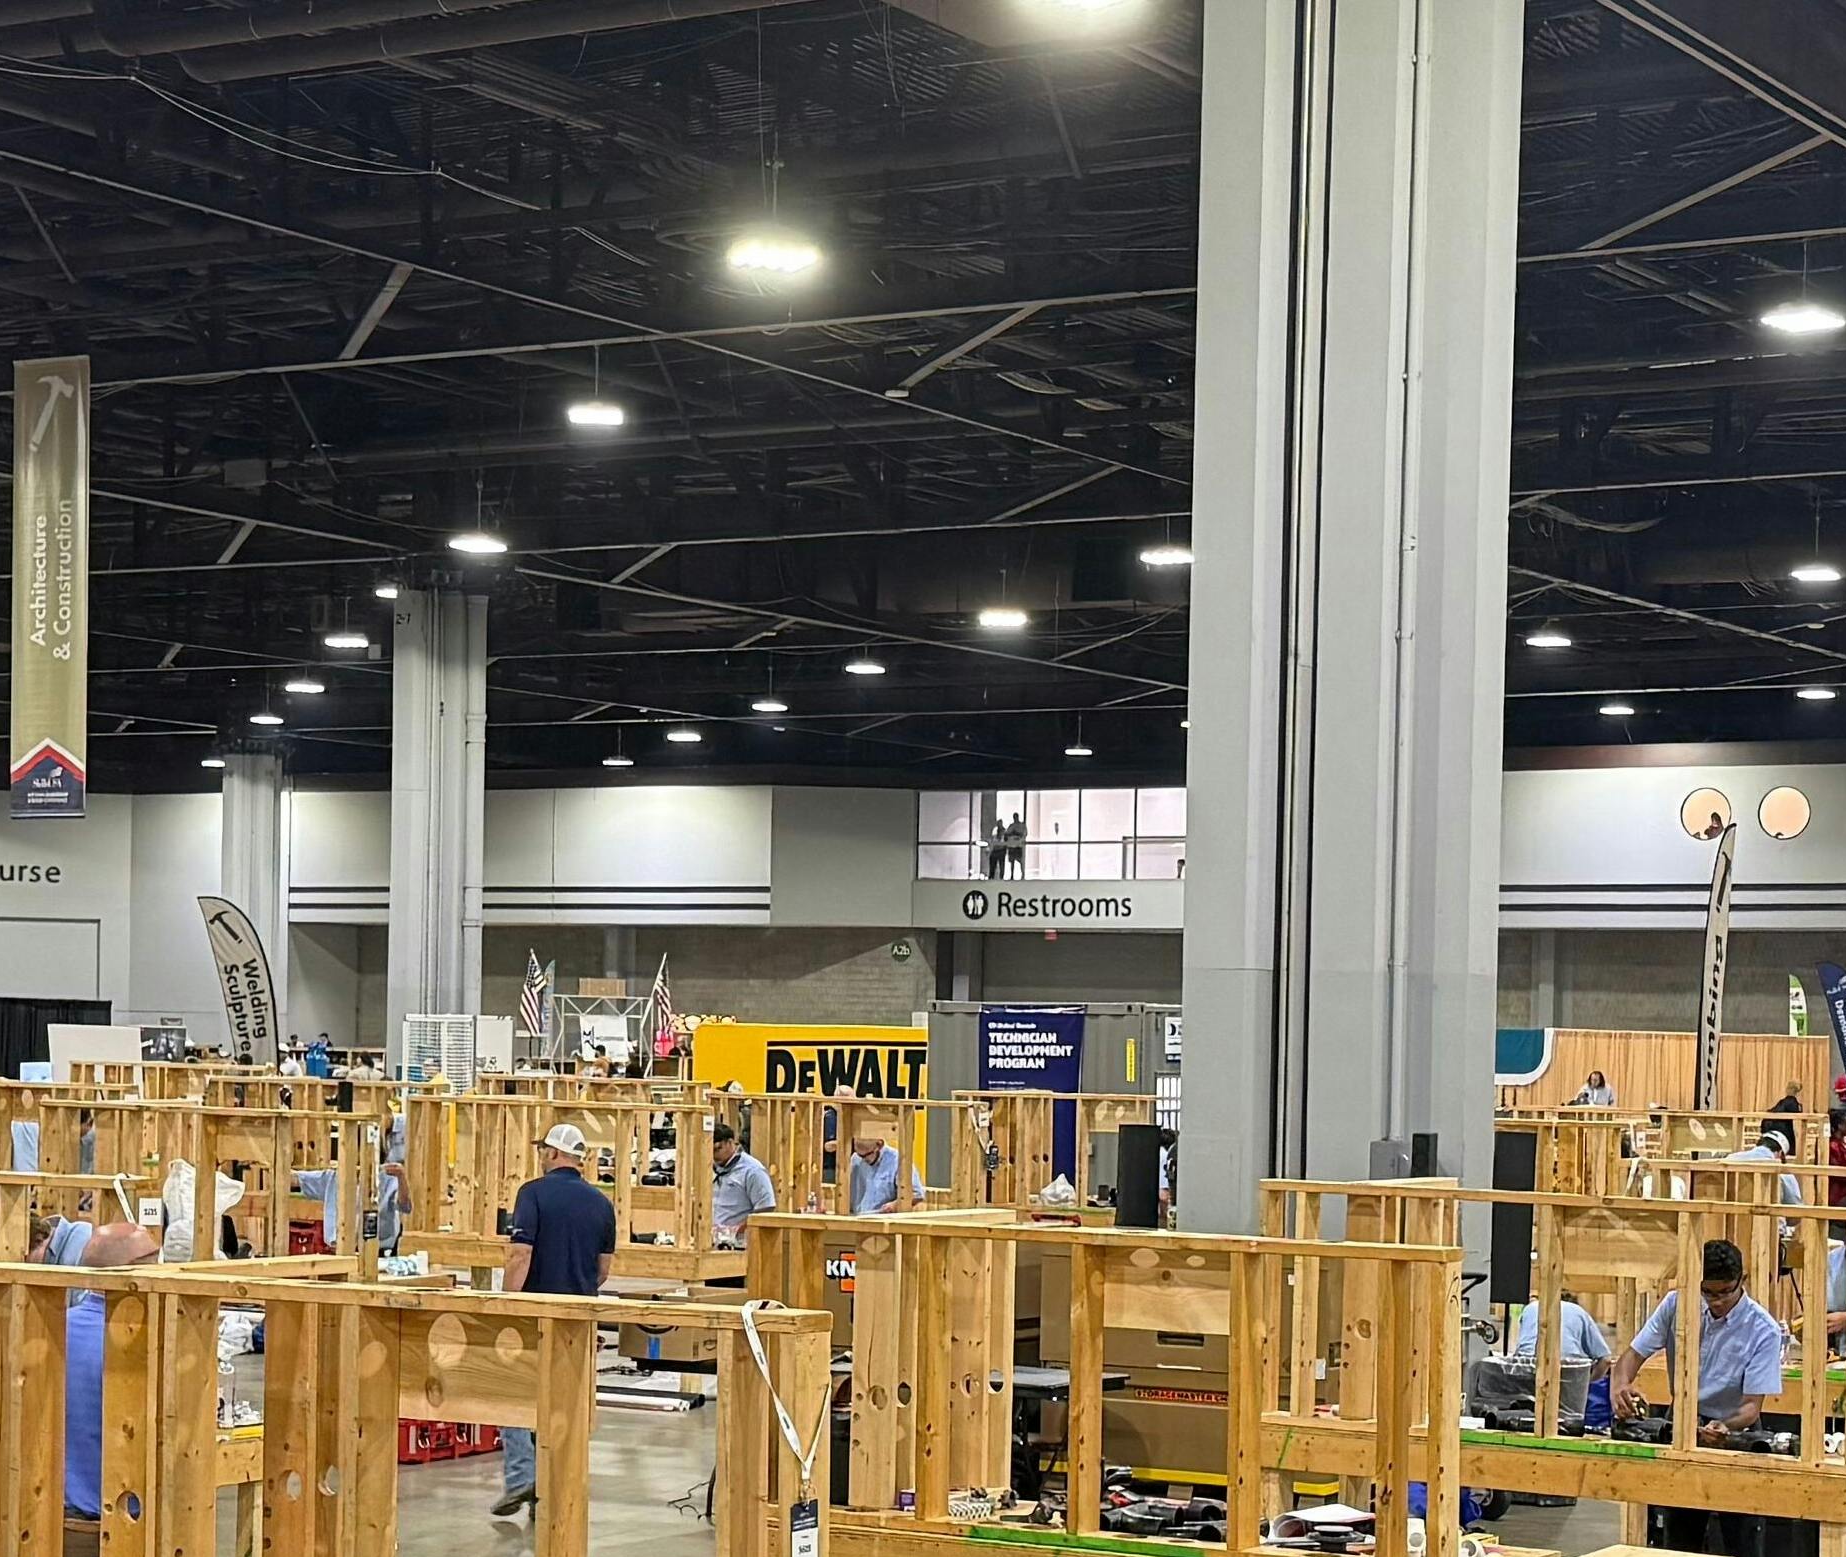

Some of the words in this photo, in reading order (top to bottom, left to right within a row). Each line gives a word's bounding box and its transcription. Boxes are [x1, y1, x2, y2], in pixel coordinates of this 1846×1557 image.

[30, 516, 47, 647] Architecture
[53, 500, 72, 636] Construction
[997, 892, 1132, 918] Restrooms
[224, 963, 252, 1055] Sculpture
[243, 958, 266, 1039] Welding
[988, 1032, 1058, 1044] TECHNICIAN
[988, 1045, 1074, 1058] DEVELOPMENT
[988, 1058, 1046, 1070] PROGRAM
